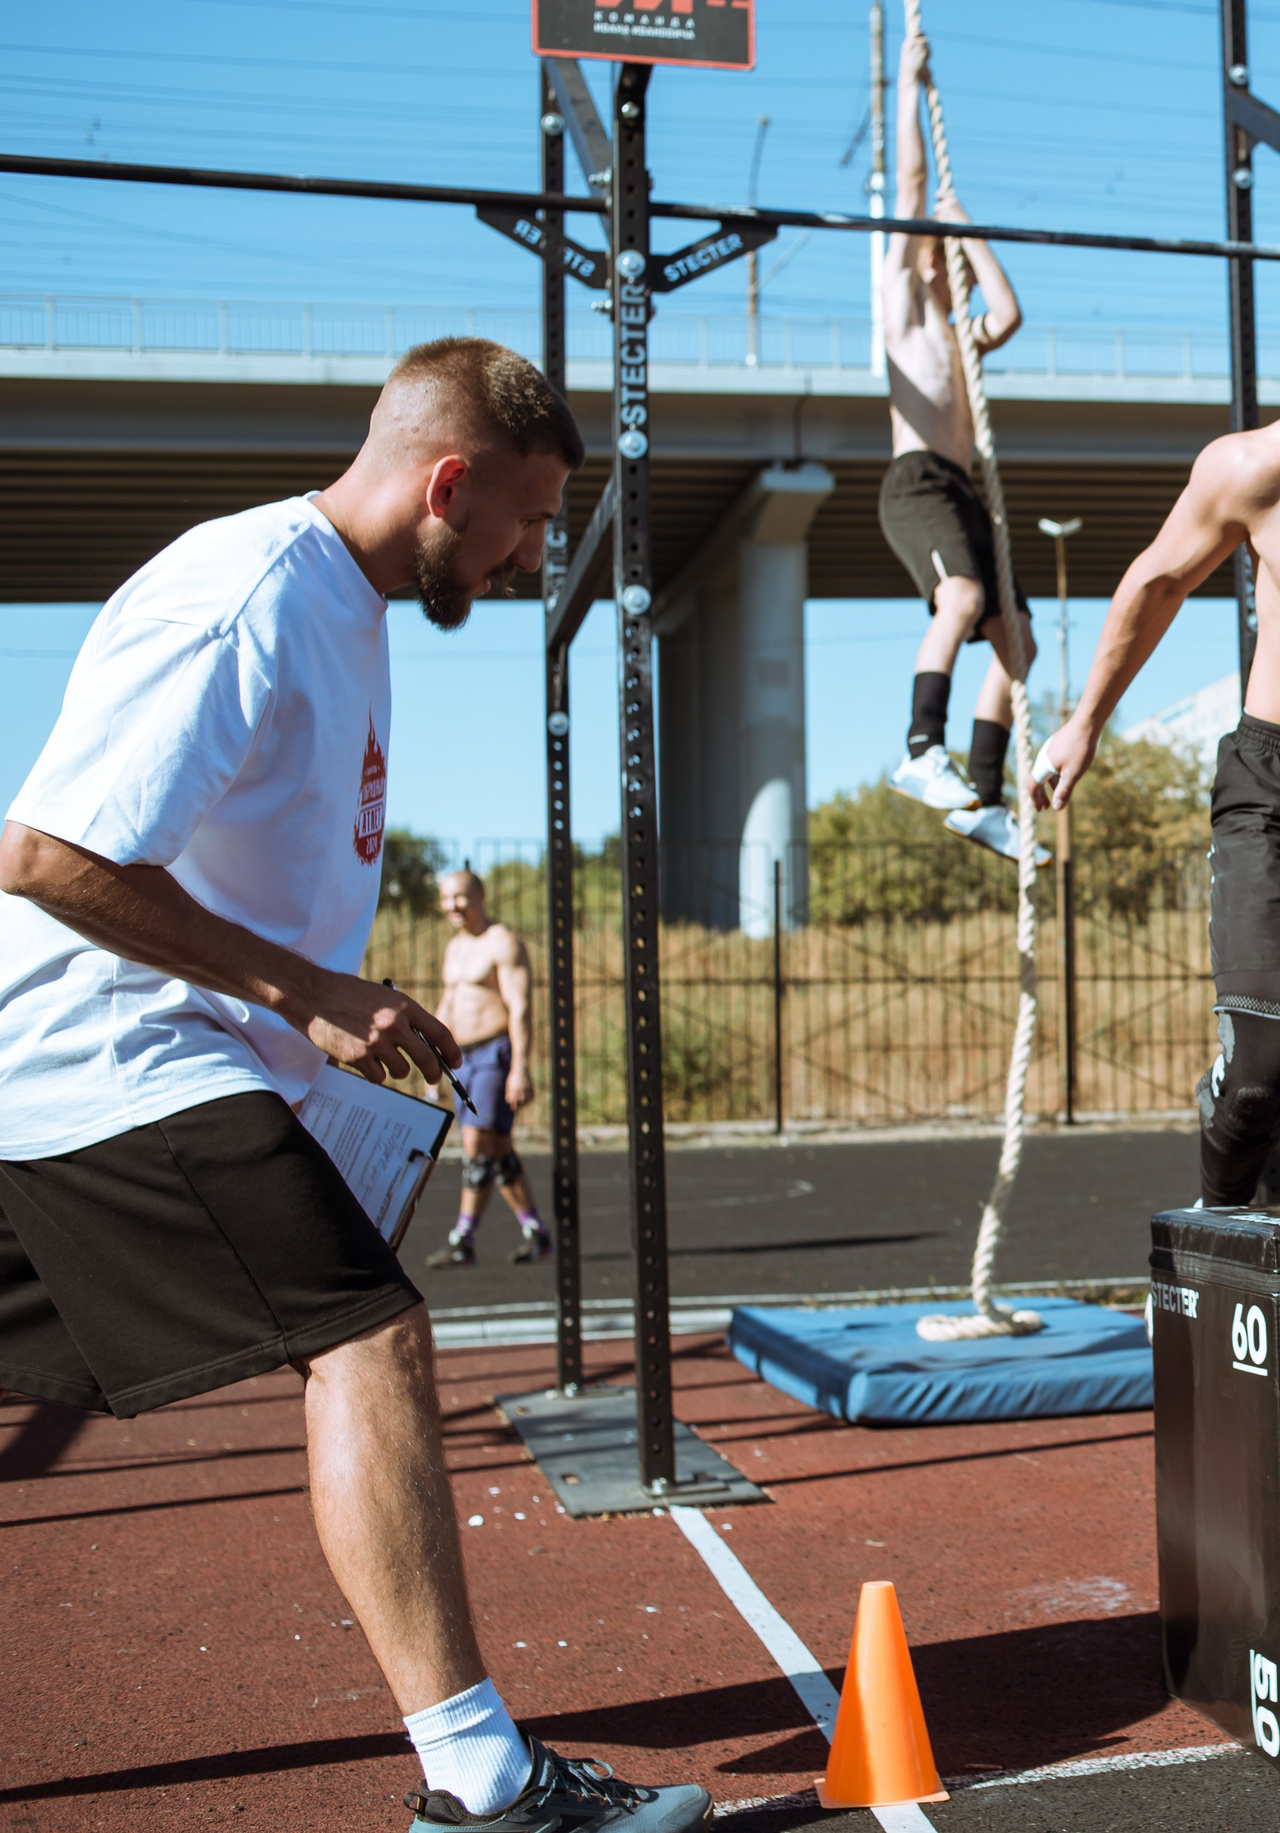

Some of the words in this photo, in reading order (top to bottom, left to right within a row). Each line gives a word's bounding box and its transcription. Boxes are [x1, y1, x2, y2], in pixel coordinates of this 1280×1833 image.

[663, 233, 743, 282] STECTER
[620, 281, 647, 427] STECTER
[1152, 1282, 1197, 1319] STECTER
[1232, 1302, 1268, 1365] 60
[1255, 1653, 1280, 1758] 50
